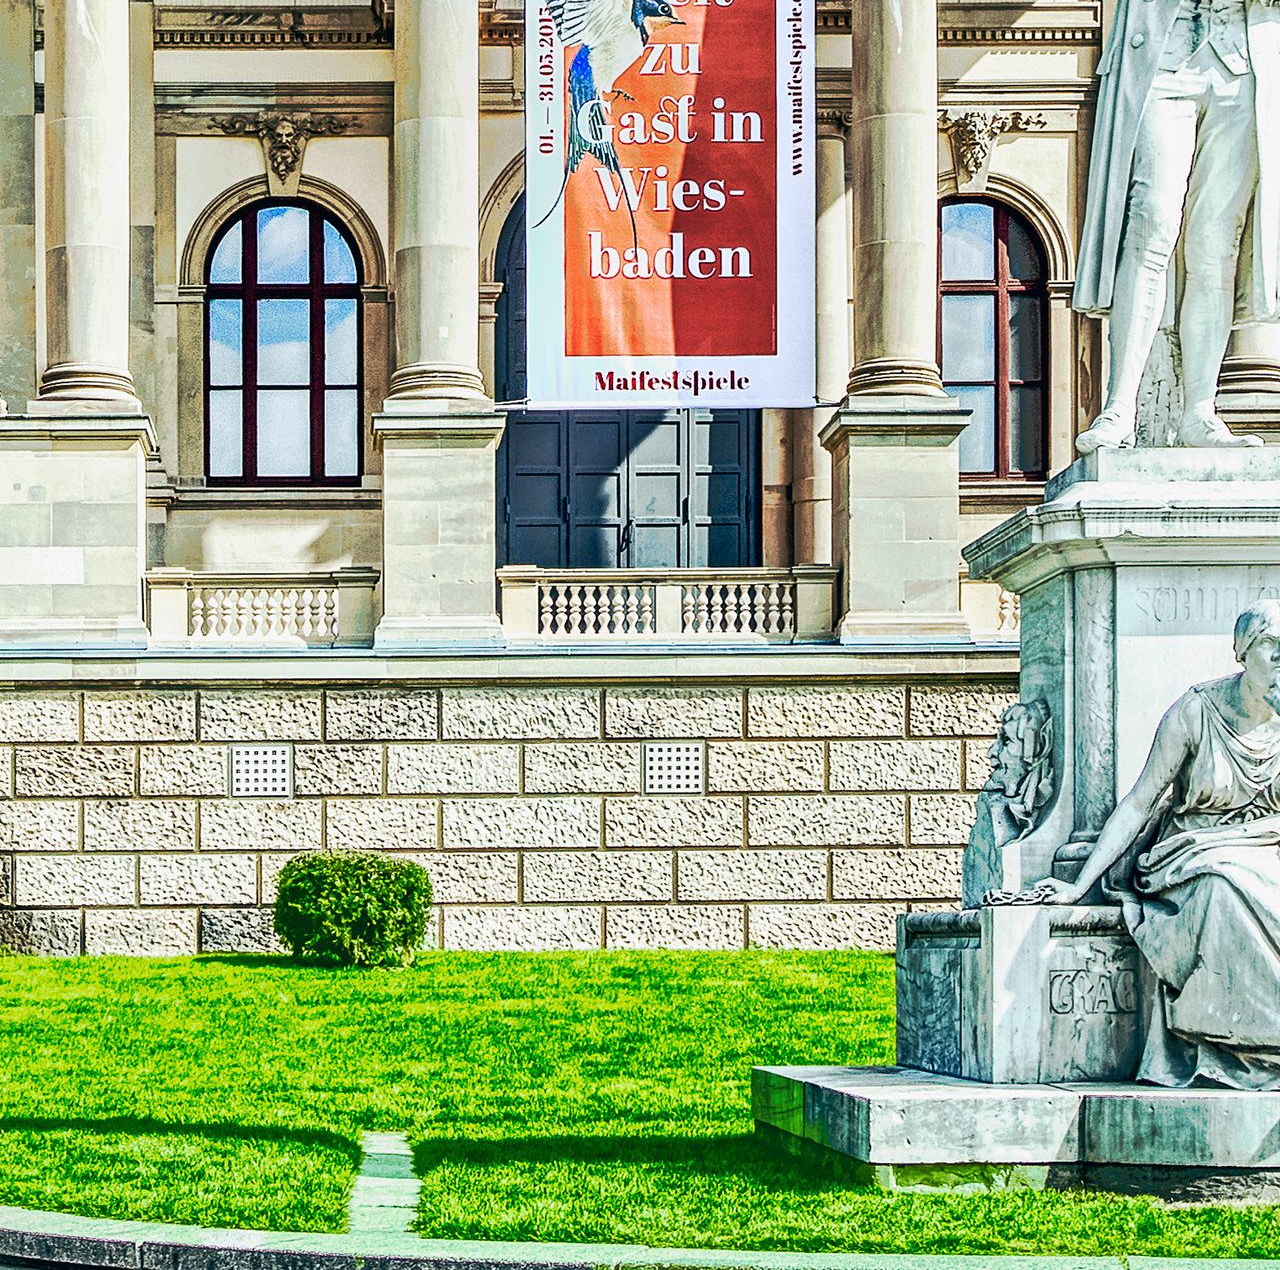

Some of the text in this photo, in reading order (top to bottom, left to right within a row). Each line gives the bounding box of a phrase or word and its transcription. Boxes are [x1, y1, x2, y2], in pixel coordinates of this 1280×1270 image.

[538, 6, 555, 102] 31.05.2015
[639, 41, 703, 76] zu
[576, 94, 765, 145] Gast in
[593, 164, 746, 213] Wies-
[587, 230, 754, 279] baden
[594, 369, 751, 396] Maifestspiele
